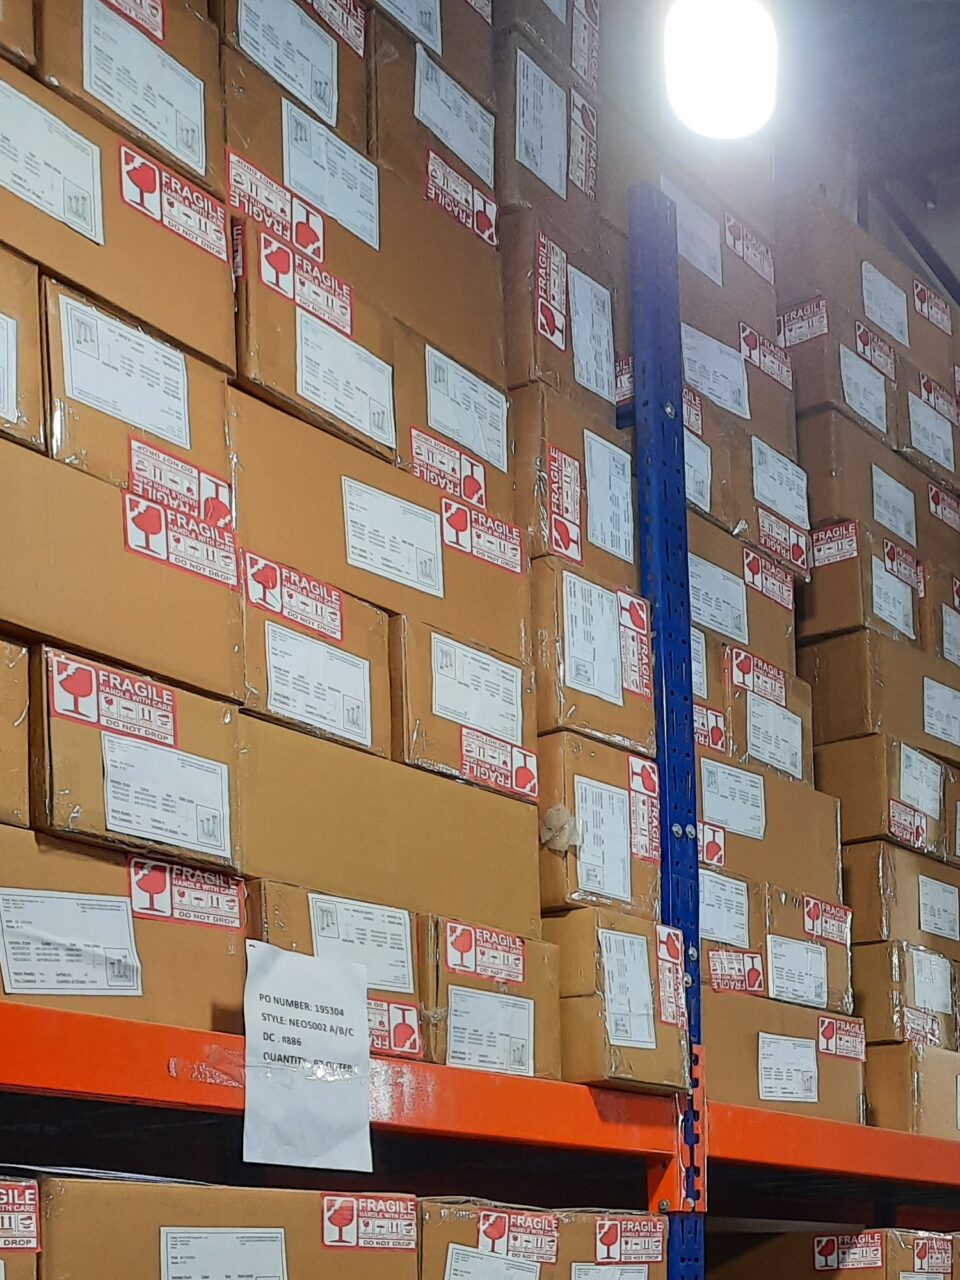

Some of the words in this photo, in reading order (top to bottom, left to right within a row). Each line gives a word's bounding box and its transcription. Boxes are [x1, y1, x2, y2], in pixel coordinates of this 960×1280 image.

[162, 174, 225, 222] FRAGILE
[230, 189, 290, 241] FRAGILE
[295, 255, 350, 299] FRAGILE
[785, 301, 826, 322] FRAGILE
[413, 463, 460, 497] FRAGILE
[551, 447, 560, 516] FRAGILE
[168, 512, 235, 547] FRAGILE
[472, 511, 520, 541] FRAGILE
[813, 523, 855, 542] FRAGILE
[168, 525, 196, 540] HANDLE
[198, 535, 215, 547] WITH
[216, 542, 234, 554] CARE
[174, 556, 186, 566] DO
[189, 561, 204, 572] NOT
[208, 568, 232, 582] DROP
[762, 560, 792, 583] FRAGILE
[282, 568, 340, 605] FRAGILE
[754, 658, 785, 679] FRAGILE
[100, 671, 173, 705] FRAGILE
[100, 685, 131, 700] HANDLE
[133, 694, 152, 706] WITH
[154, 700, 173, 712] CARE
[106, 718, 119, 728] DO
[123, 722, 139, 733] NOT
[144, 728, 169, 742] DROP
[463, 761, 511, 787] FRAGILE
[173, 867, 238, 892] FRAGILE
[173, 879, 202, 891] HANDLE
[204, 885, 220, 894] WITH
[222, 888, 238, 897] CARE
[179, 911, 191, 919] DO
[194, 913, 210, 921] NOT
[213, 916, 236, 925] DROP
[477, 929, 523, 950] FRAGILE
[259, 994, 271, 1003] PO
[273, 996, 312, 1011] NUMBER:
[315, 1005, 344, 1016] 195304
[262, 1013, 286, 1024] STYLE:
[289, 1018, 327, 1032] NEO5002
[330, 1027, 354, 1036] A/B/C
[263, 1032, 275, 1042] DC
[358, 1199, 415, 1214] FRAGILE
[510, 1215, 558, 1231] FRAGILE
[622, 1222, 663, 1233] FRAGILE
[839, 1234, 881, 1246] FRAGILE
